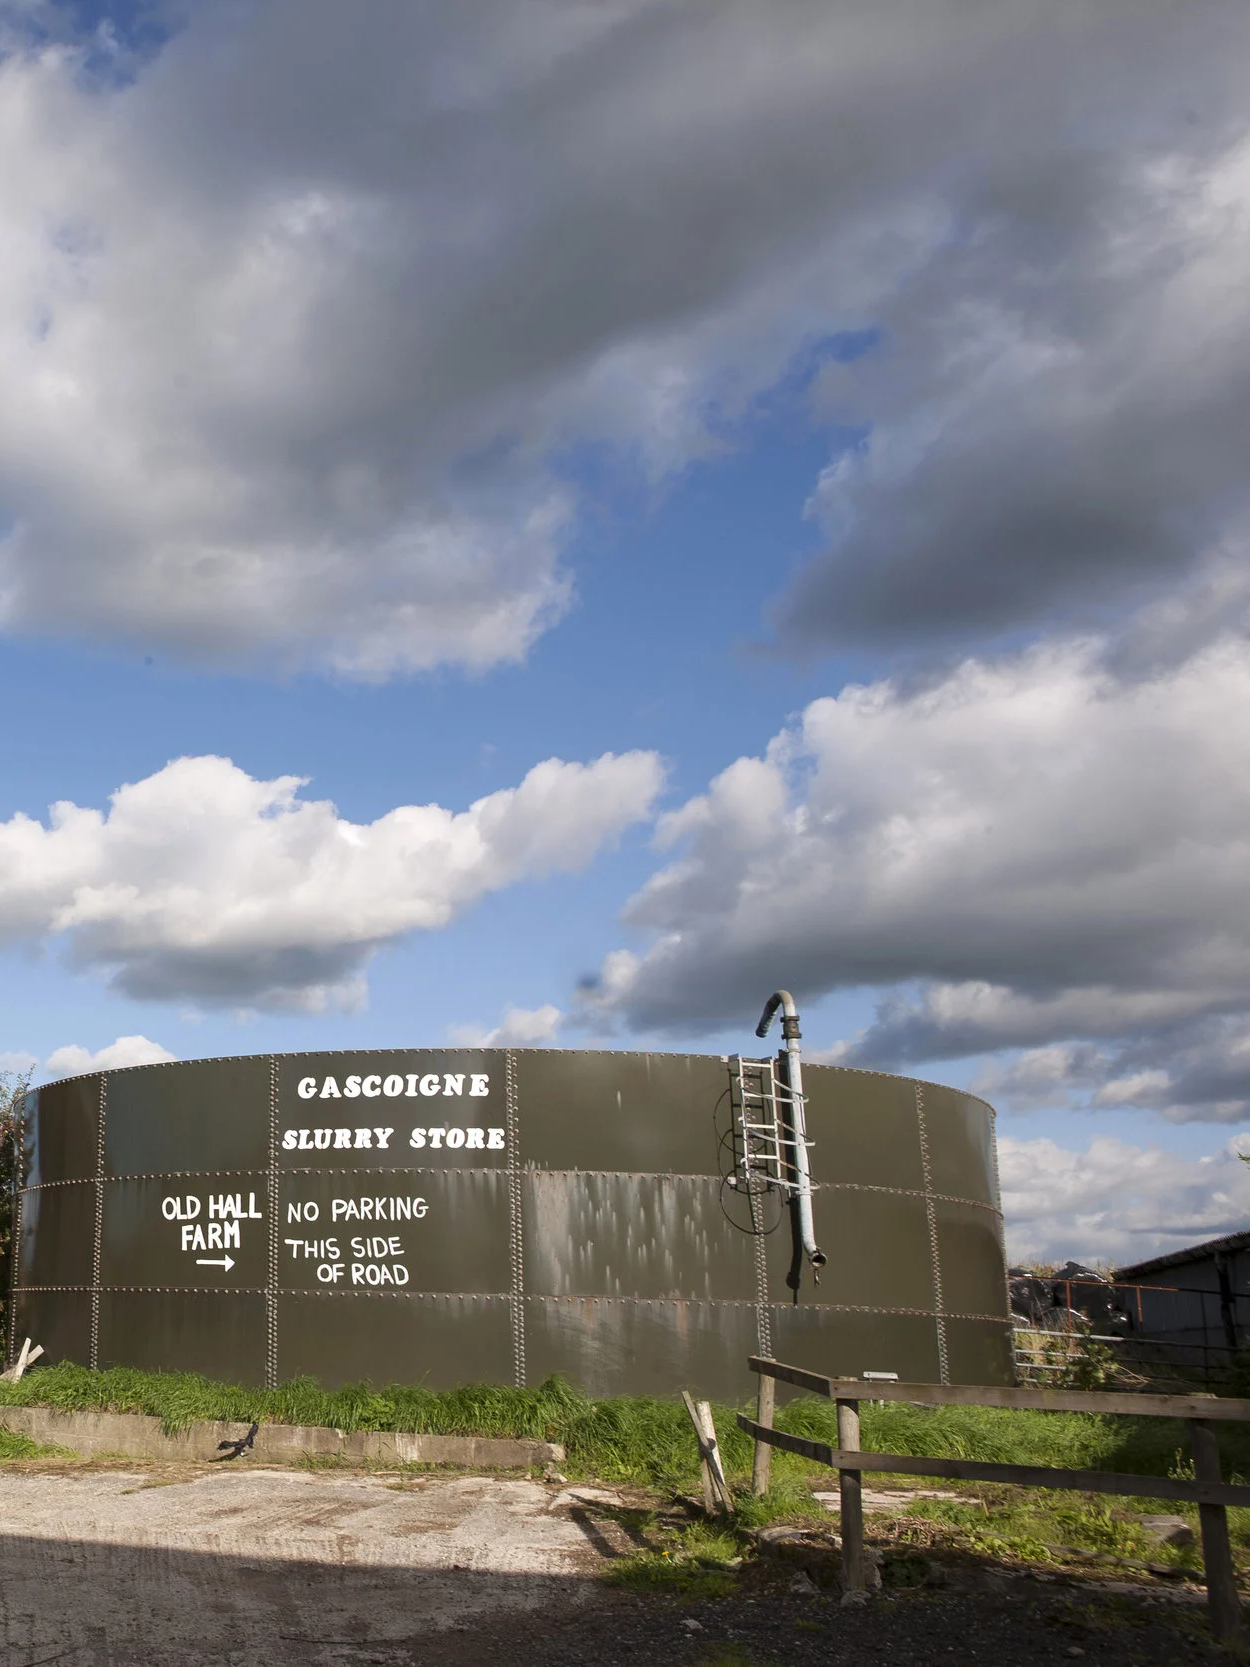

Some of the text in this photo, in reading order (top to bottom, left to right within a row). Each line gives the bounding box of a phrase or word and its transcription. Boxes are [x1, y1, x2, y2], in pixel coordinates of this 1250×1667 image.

[297, 1073, 490, 1099] GASCOIGNE
[281, 1127, 505, 1150] SLURRY STORE
[161, 1192, 263, 1221] OLD HALL
[287, 1197, 430, 1224] NO PARKING
[181, 1219, 241, 1251] FARM
[284, 1236, 405, 1259] THIS SIDE
[316, 1263, 409, 1286] OF ROAD
